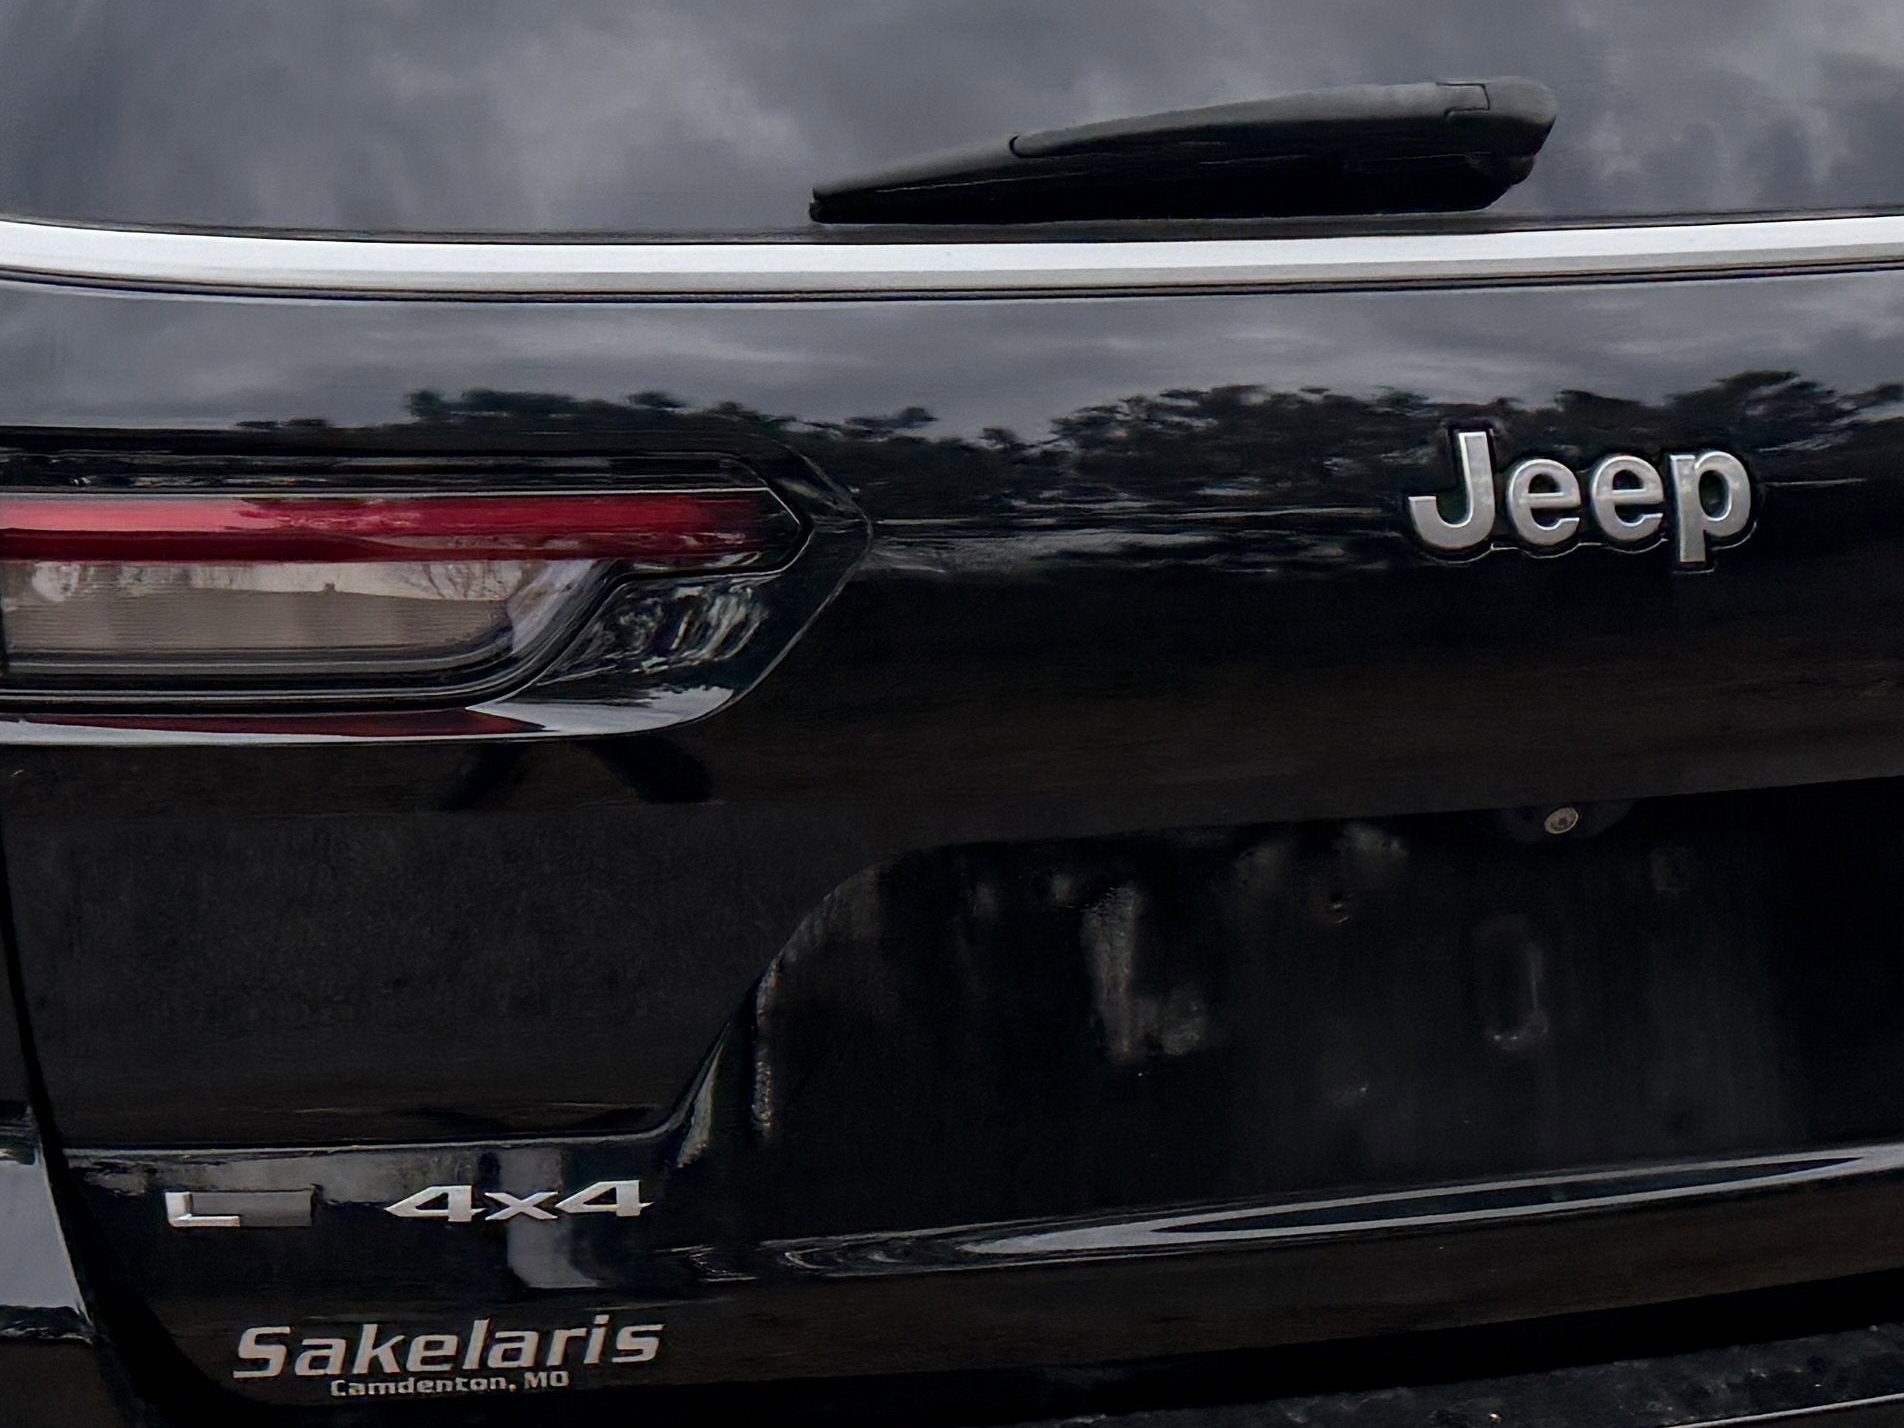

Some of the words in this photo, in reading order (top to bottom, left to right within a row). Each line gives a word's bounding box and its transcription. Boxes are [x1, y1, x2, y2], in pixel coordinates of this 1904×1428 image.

[1407, 430, 1753, 563] Jeep
[163, 1190, 242, 1228] L
[382, 1179, 656, 1224] 4x4
[231, 1313, 667, 1380] Sakelaris
[329, 1375, 518, 1398] Camdenton,
[523, 1369, 571, 1390] MO
